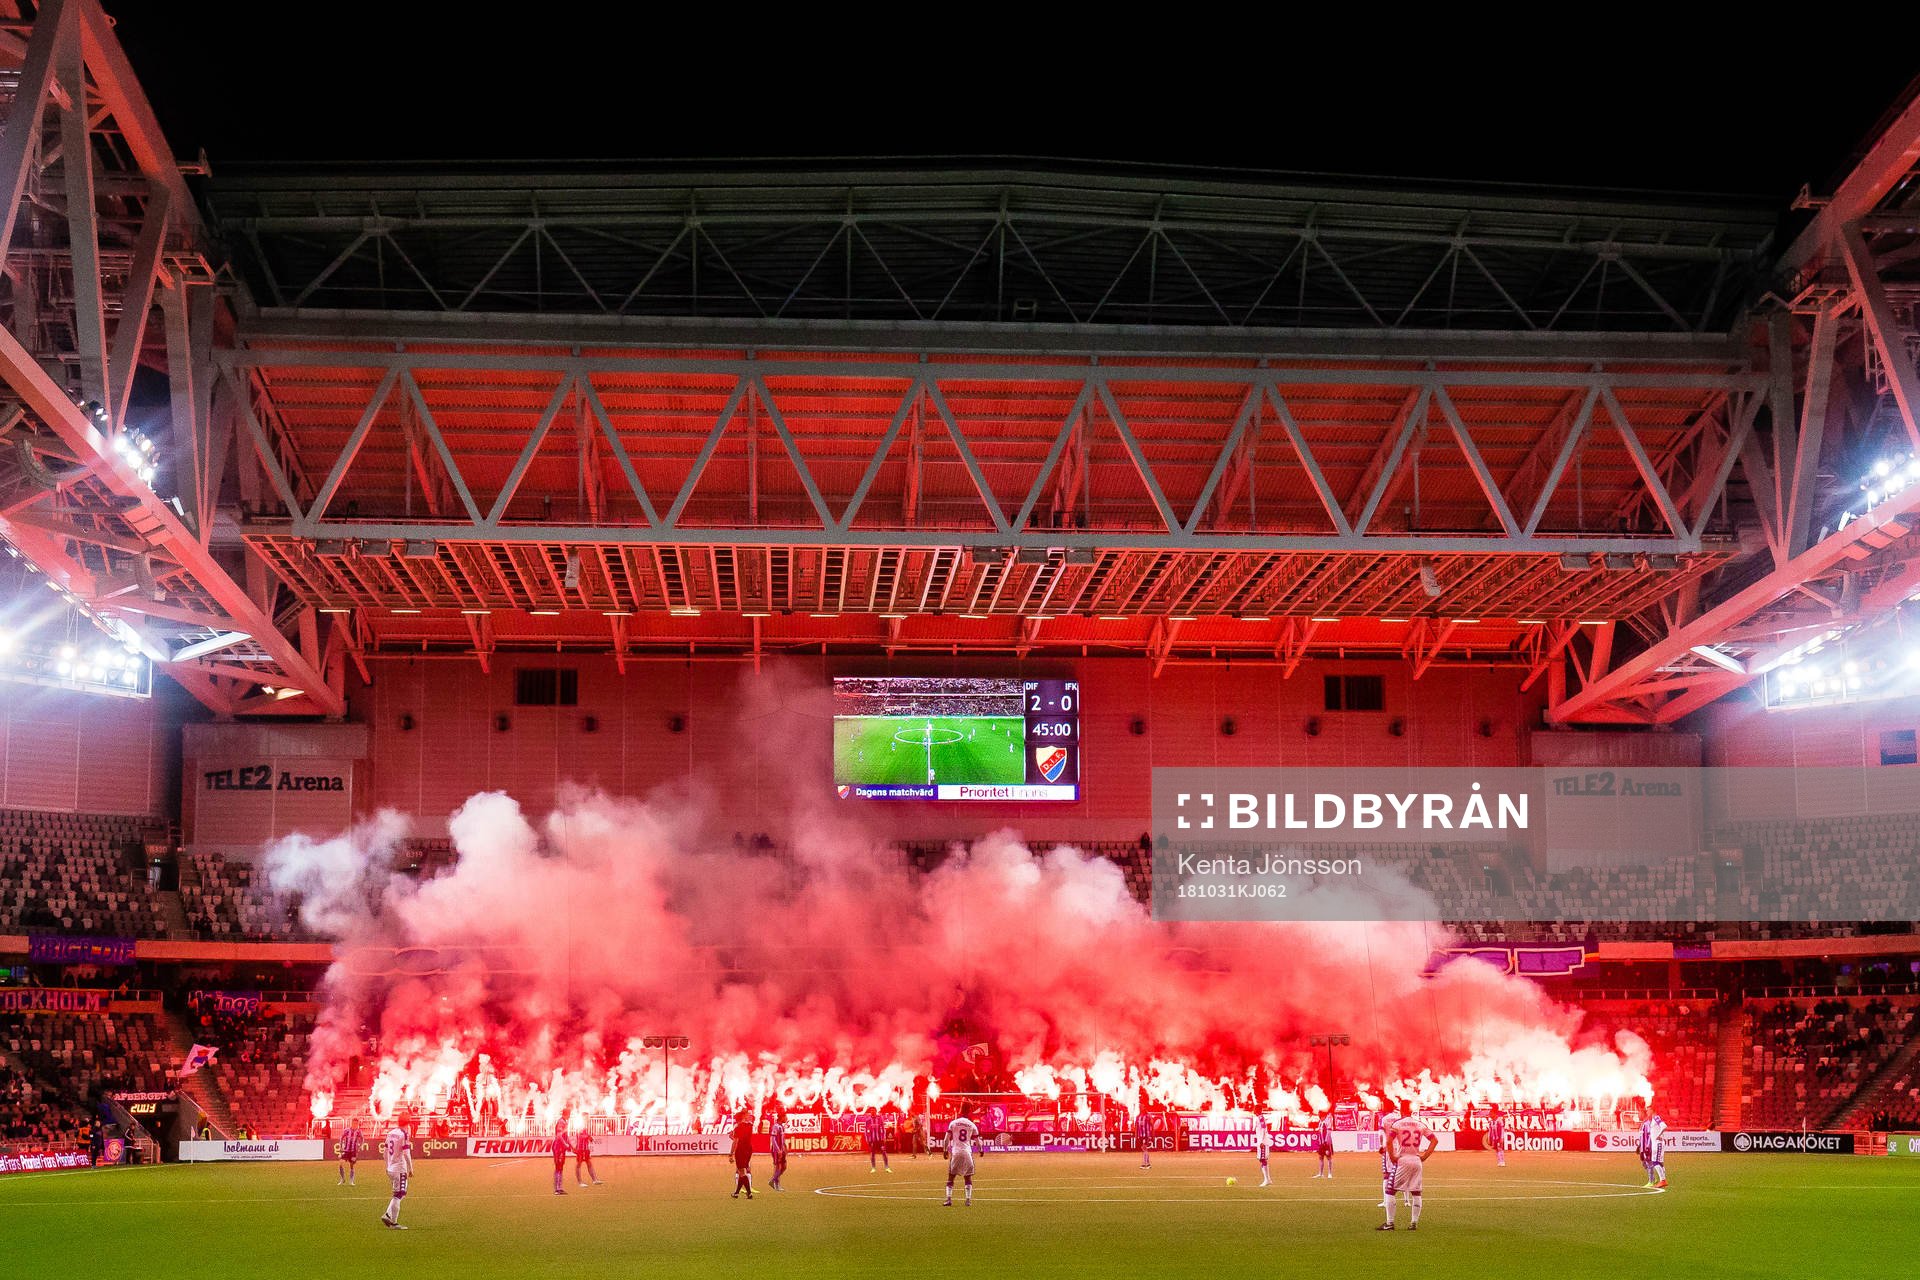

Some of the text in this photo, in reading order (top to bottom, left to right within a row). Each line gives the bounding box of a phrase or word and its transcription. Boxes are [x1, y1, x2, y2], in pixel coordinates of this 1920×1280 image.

[1031, 695, 1041, 711] 2
[1061, 695, 1072, 711] 0
[1032, 723, 1071, 736] 45:00
[204, 765, 344, 791] TELE2 Arena
[1553, 771, 1682, 796] TELE2 Arena
[856, 786, 934, 798] Dagens matchvärd
[960, 786, 1009, 798] Prioritet
[0, 990, 100, 1011] OCKHOLM
[959, 1128, 967, 1142] 8
[1040, 1133, 1116, 1149] Prioritet
[1401, 1130, 1421, 1148] 23
[1504, 1131, 1564, 1151] Rekomo
[1753, 1133, 1841, 1150] HAGAKÖKET
[423, 1140, 457, 1156] gibon
[653, 1139, 718, 1151] Infometric
[786, 1136, 828, 1151] ringsö
